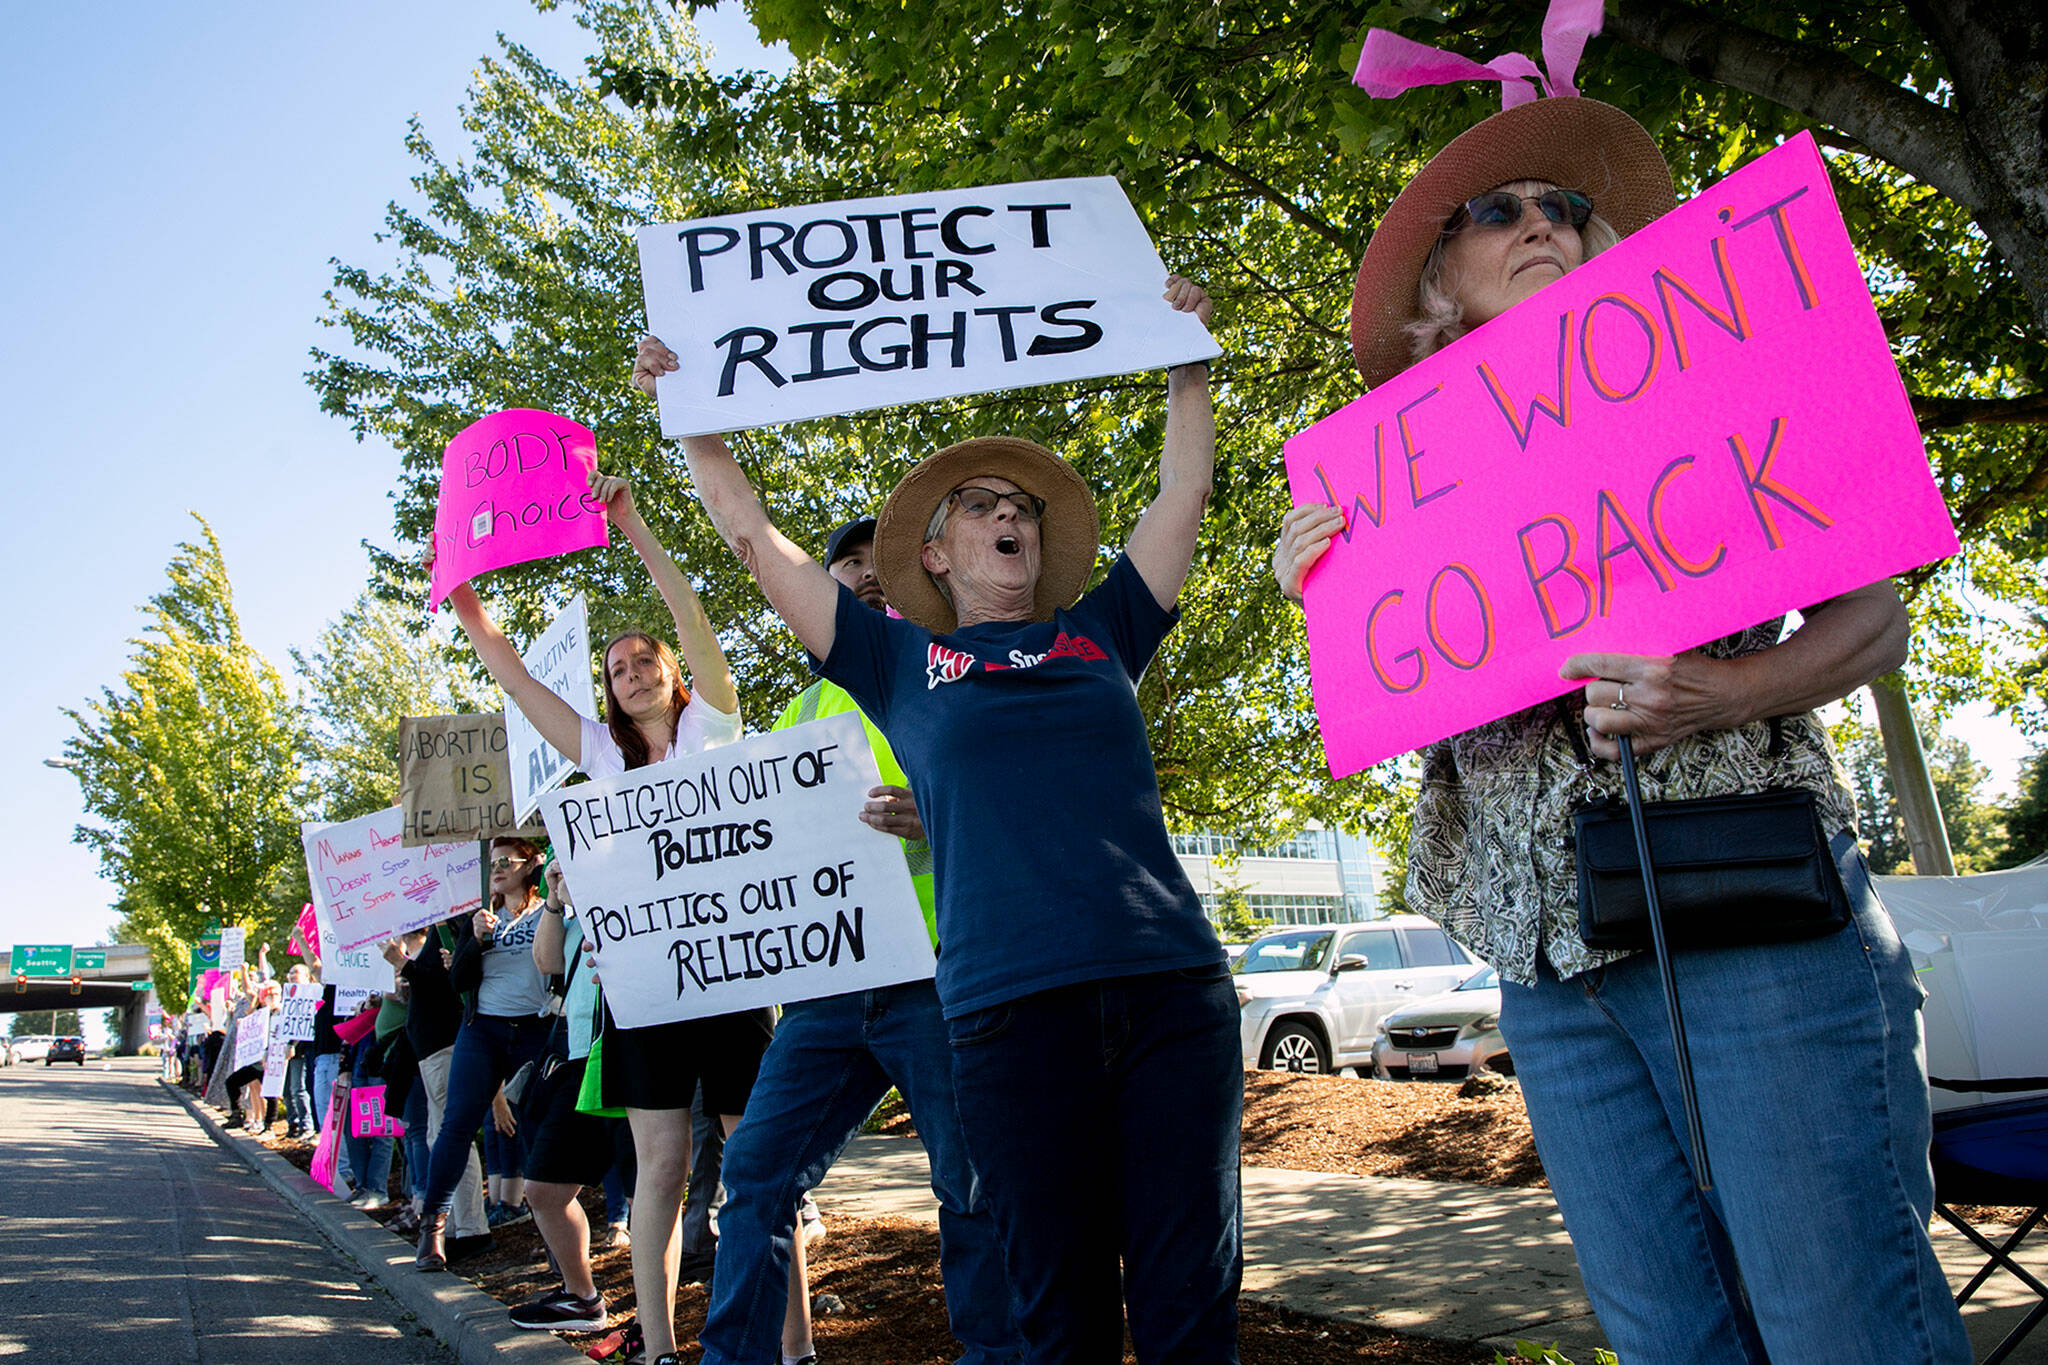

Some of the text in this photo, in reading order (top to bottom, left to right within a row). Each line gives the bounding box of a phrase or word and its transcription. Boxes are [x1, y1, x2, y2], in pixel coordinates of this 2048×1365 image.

[679, 204, 1071, 292] PROTECT
[808, 260, 986, 311] OUR
[714, 300, 1103, 397] RIGHTS
[1314, 185, 1819, 544] WE WON'T
[465, 427, 571, 489] BODY
[1366, 416, 1835, 695] GO BACK
[406, 726, 507, 762] ABORTIO
[461, 764, 493, 794] IS
[559, 744, 839, 860] RELIGION OUT OF
[382, 858, 411, 877] STOP
[647, 819, 774, 881] POLITICS
[330, 900, 356, 921] IT
[362, 890, 396, 911] STOPS
[399, 872, 435, 892] SAFE
[586, 861, 855, 954] POLITICS OUT OF
[667, 907, 866, 1001] RELIGION
[338, 989, 367, 997] Health
